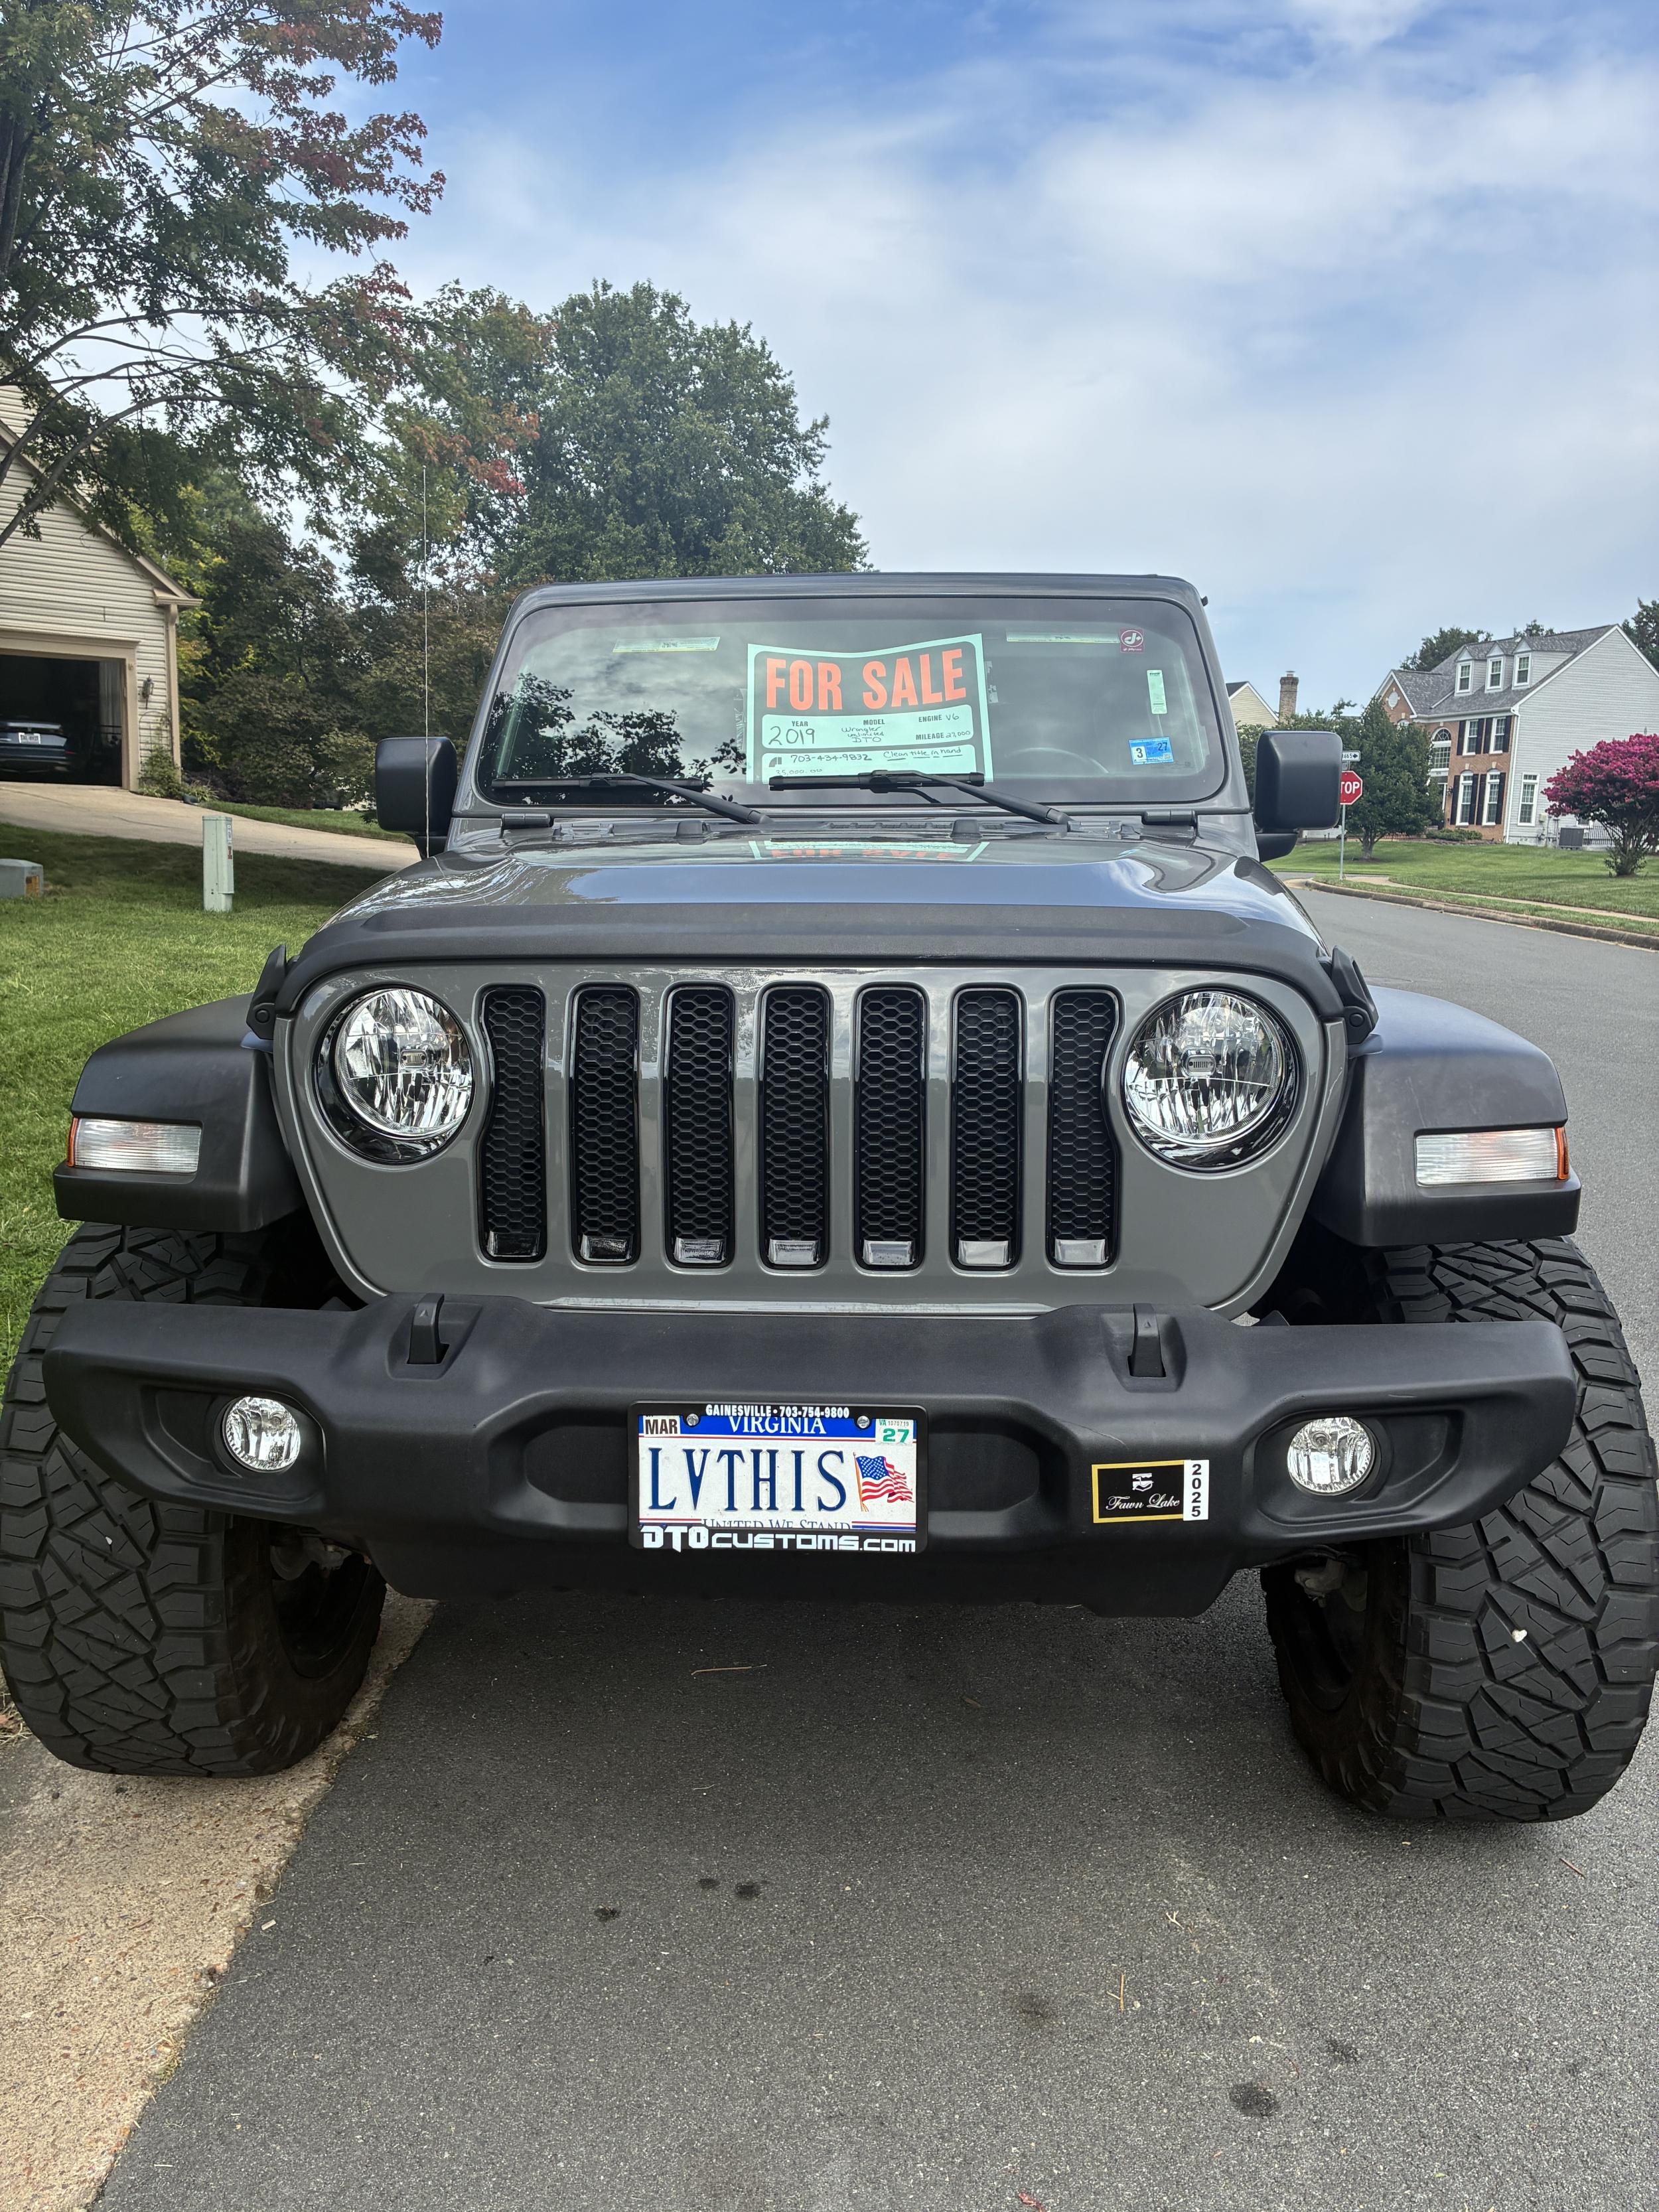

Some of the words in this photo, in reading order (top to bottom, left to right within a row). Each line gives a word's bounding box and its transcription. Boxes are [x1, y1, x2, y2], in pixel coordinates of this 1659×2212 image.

[766, 658, 843, 710] FOR
[862, 648, 966, 709] SALE
[946, 713, 960, 721] V6
[768, 726, 816, 745] 2019
[1135, 747, 1143, 758] 3
[1157, 742, 1168, 751] 27
[791, 753, 872, 763] 703-434-9832
[1340, 781, 1360, 794] TOP
[705, 1404, 771, 1417] GAINESVILLE
[779, 1406, 850, 1419] 703-754-9800
[645, 1418, 678, 1435] MAR
[729, 1416, 827, 1435] VIRGINIA
[883, 1428, 910, 1443] 27
[648, 1447, 847, 1512] LVTHIS
[1191, 1463, 1202, 1517] 2025
[1106, 1495, 1145, 1511] Fawn
[1146, 1493, 1181, 1509] Lake
